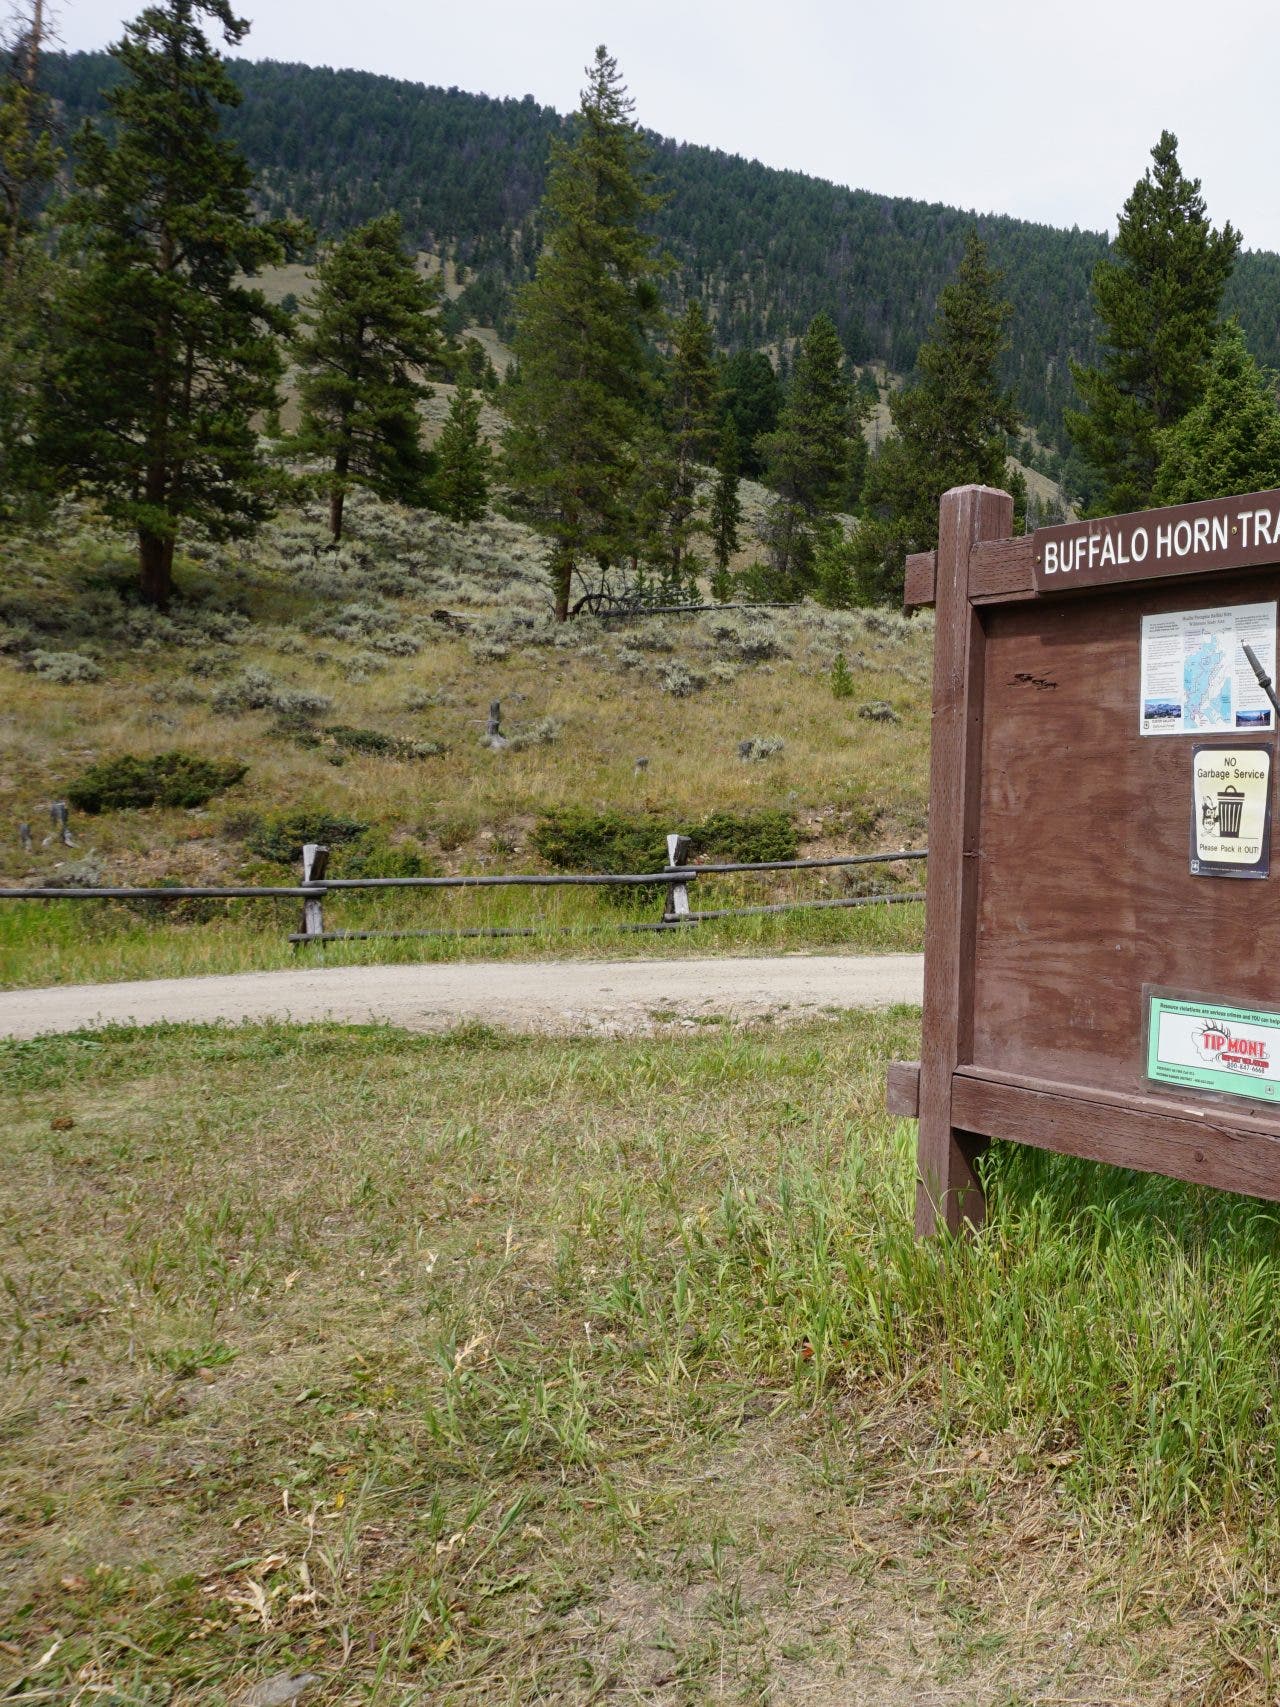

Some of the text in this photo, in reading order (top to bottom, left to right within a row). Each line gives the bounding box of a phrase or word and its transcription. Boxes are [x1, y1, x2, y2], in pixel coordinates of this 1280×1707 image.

[1044, 527, 1149, 575] BUFFALO
[1156, 514, 1228, 559] HORN
[1224, 757, 1236, 766] NO
[1198, 768, 1264, 780] Garbage Service
[1200, 844, 1218, 852] Please
[1220, 844, 1234, 852] Pack
[1160, 1002, 1178, 1010] Resource
[1180, 1005, 1200, 1013] violations
[1270, 1017, 1280, 1025] help
[1204, 1033, 1264, 1057] TIP MONT
